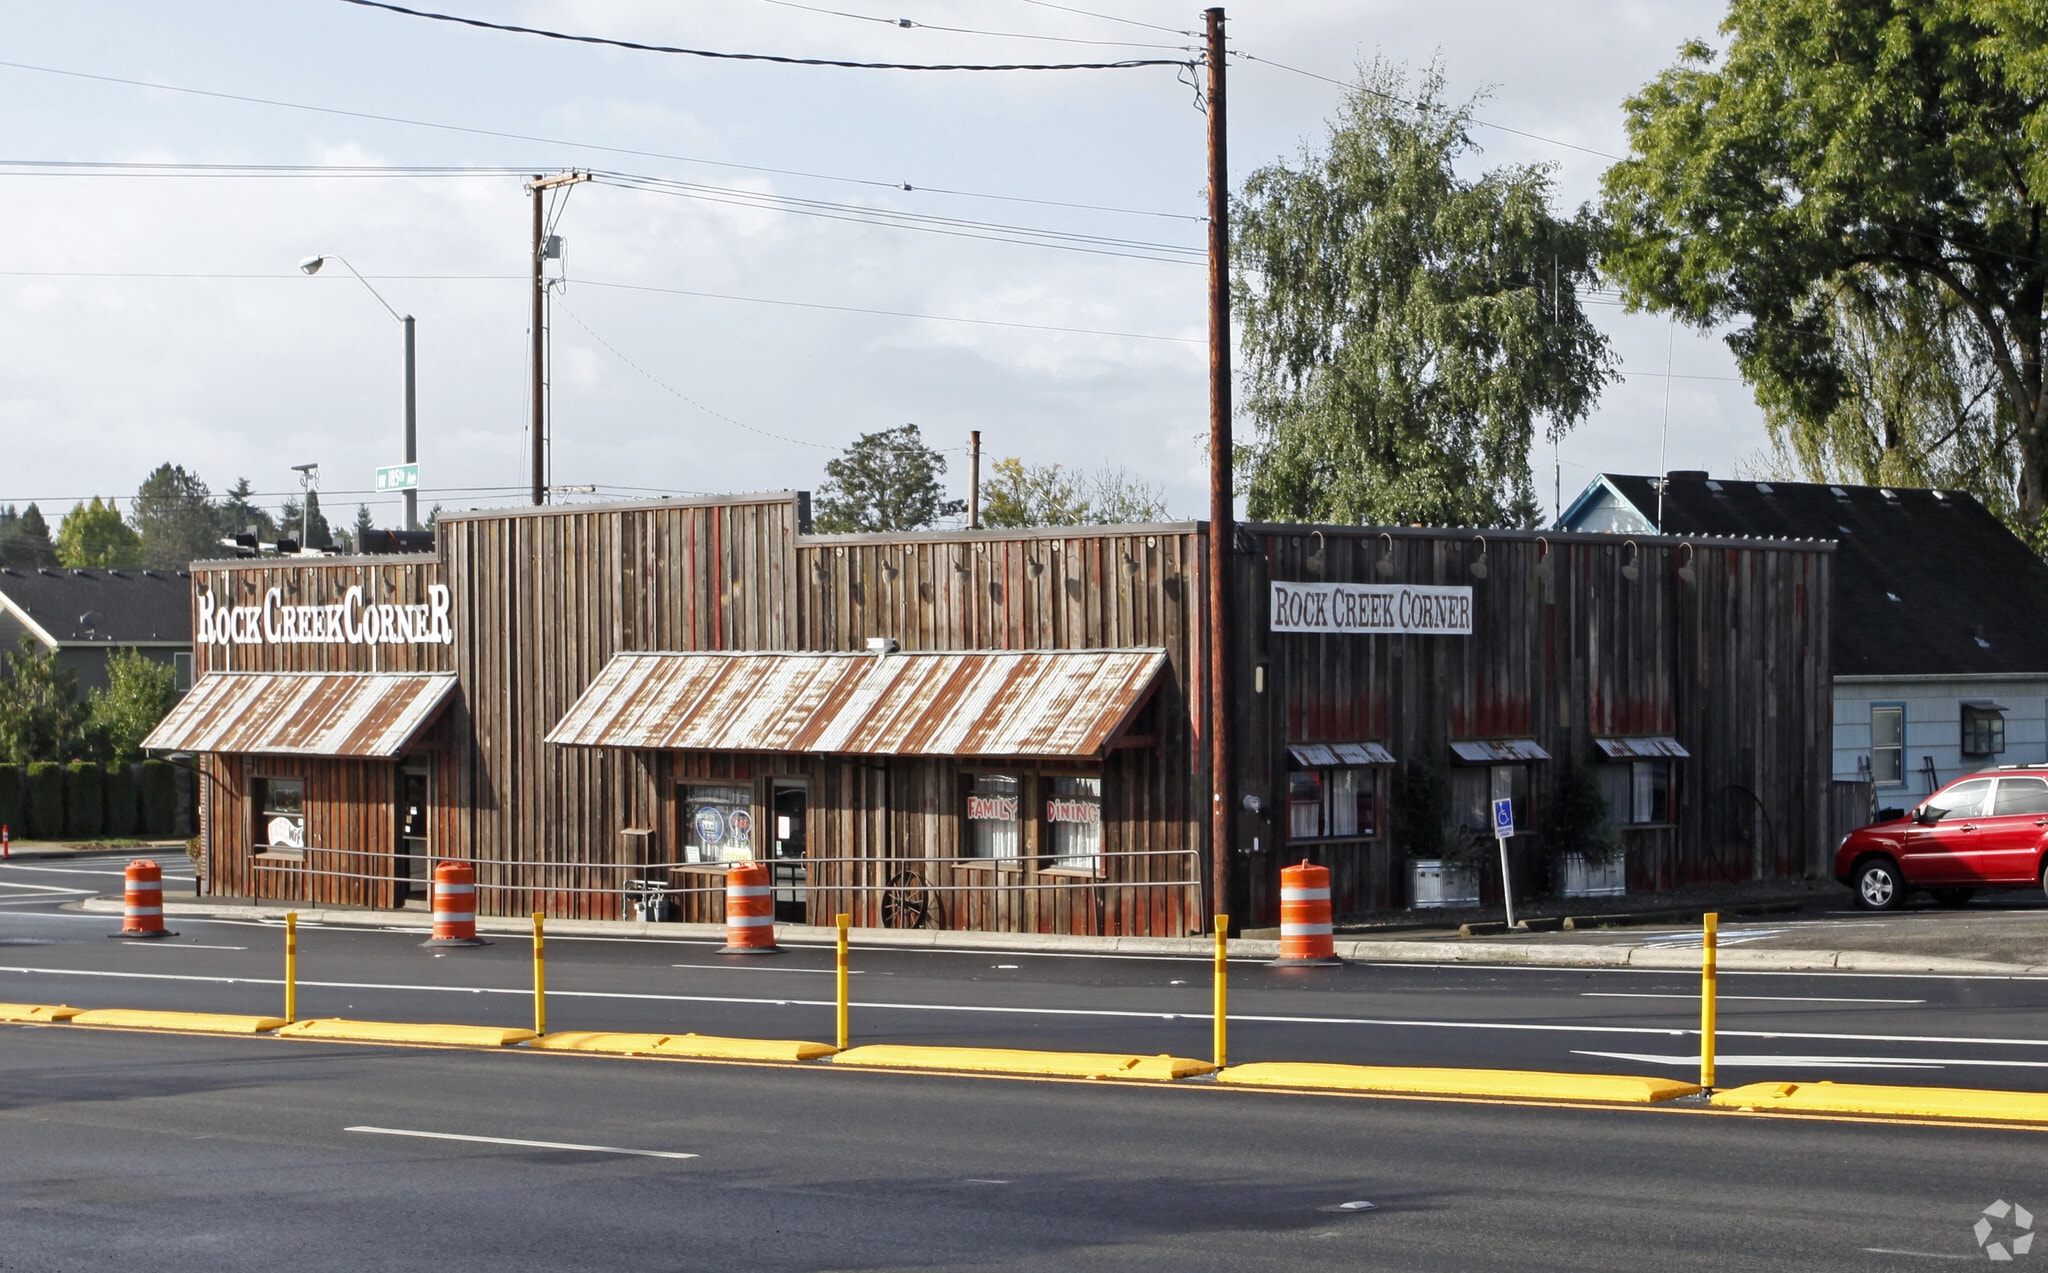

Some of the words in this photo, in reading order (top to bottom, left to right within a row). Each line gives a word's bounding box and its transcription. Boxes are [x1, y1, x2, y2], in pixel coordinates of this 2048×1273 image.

[197, 588, 262, 645] ROCK
[264, 586, 345, 645] CREEK
[344, 584, 452, 645] CORNER
[1274, 586, 1328, 627] ROCK
[1332, 587, 1395, 628] CREEK
[1399, 589, 1470, 629] CORNER
[967, 796, 1018, 822] FAMILY
